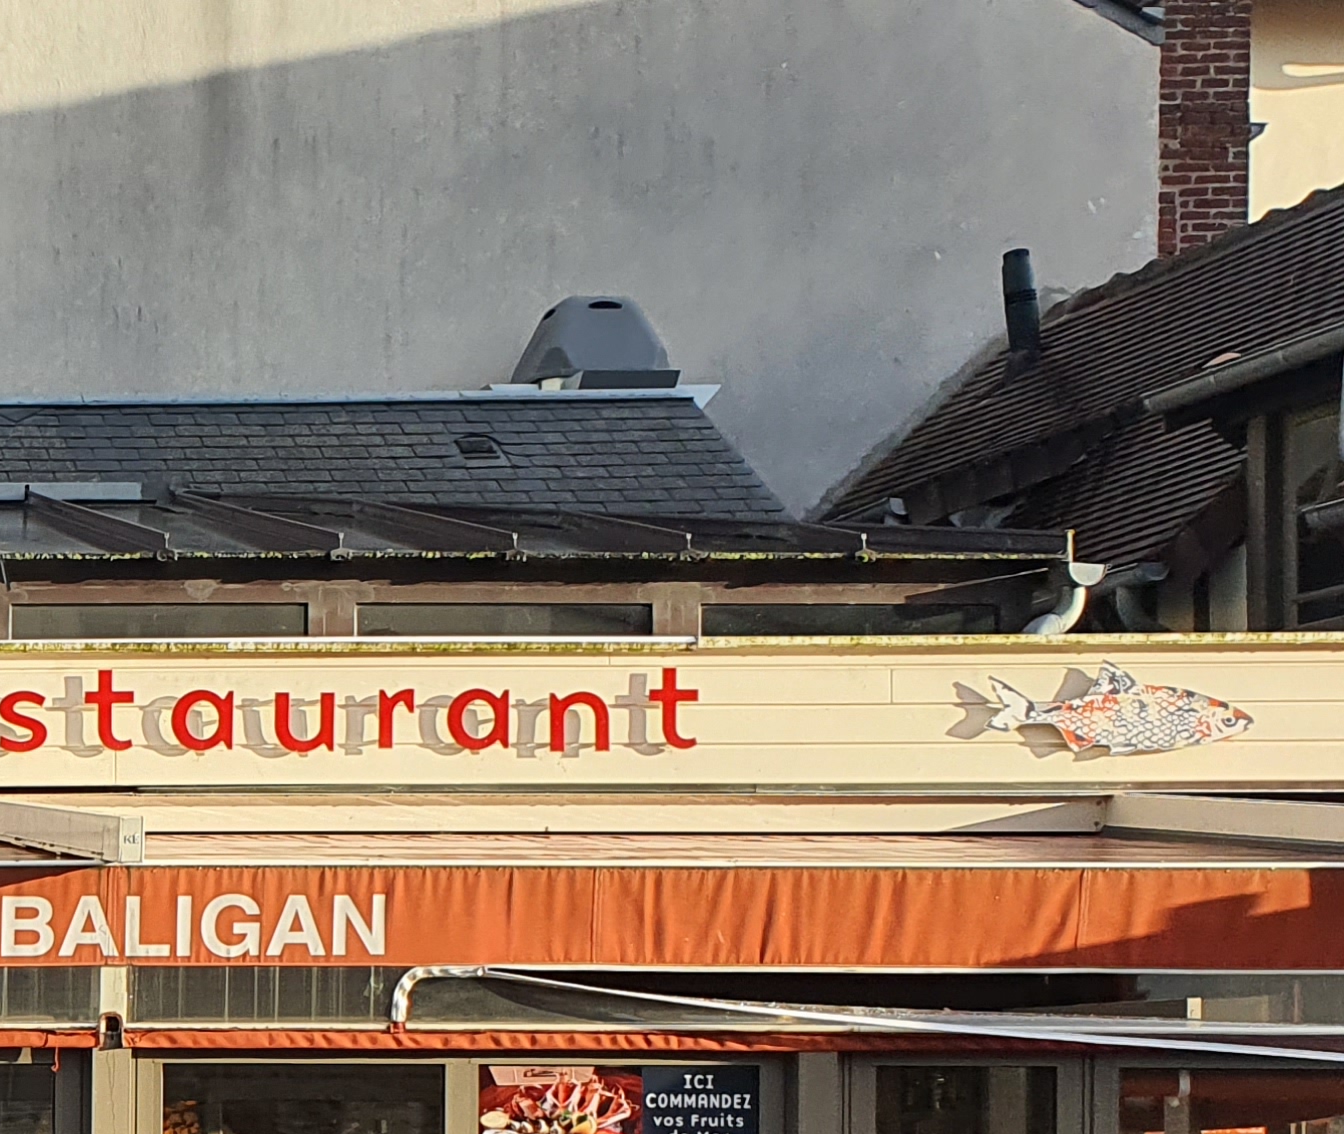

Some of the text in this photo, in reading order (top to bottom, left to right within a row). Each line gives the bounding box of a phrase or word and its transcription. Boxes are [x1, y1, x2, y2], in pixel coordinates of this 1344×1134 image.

[1, 893, 386, 958] BALIGAN
[683, 1074, 714, 1089] ICI
[645, 1093, 752, 1109] COMMANDEZ
[653, 1113, 744, 1127] vos Fruits
